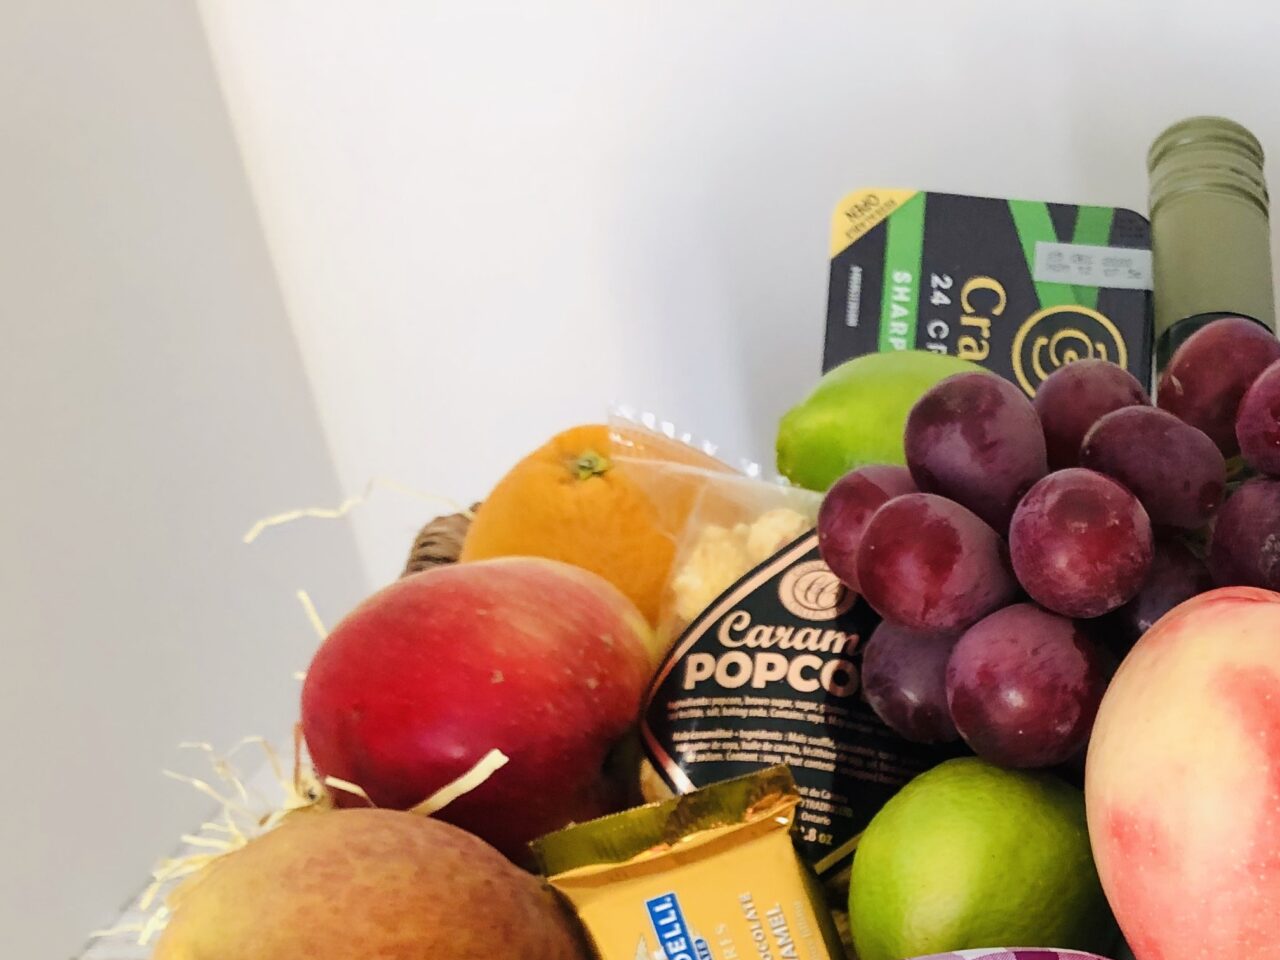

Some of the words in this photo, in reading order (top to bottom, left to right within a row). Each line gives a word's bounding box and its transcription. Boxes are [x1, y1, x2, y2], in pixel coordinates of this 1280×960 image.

[888, 270, 913, 351] SHARP
[930, 273, 953, 306] 24
[957, 276, 1007, 361] Cra
[716, 609, 860, 656] Caram
[683, 650, 859, 698] POPCO
